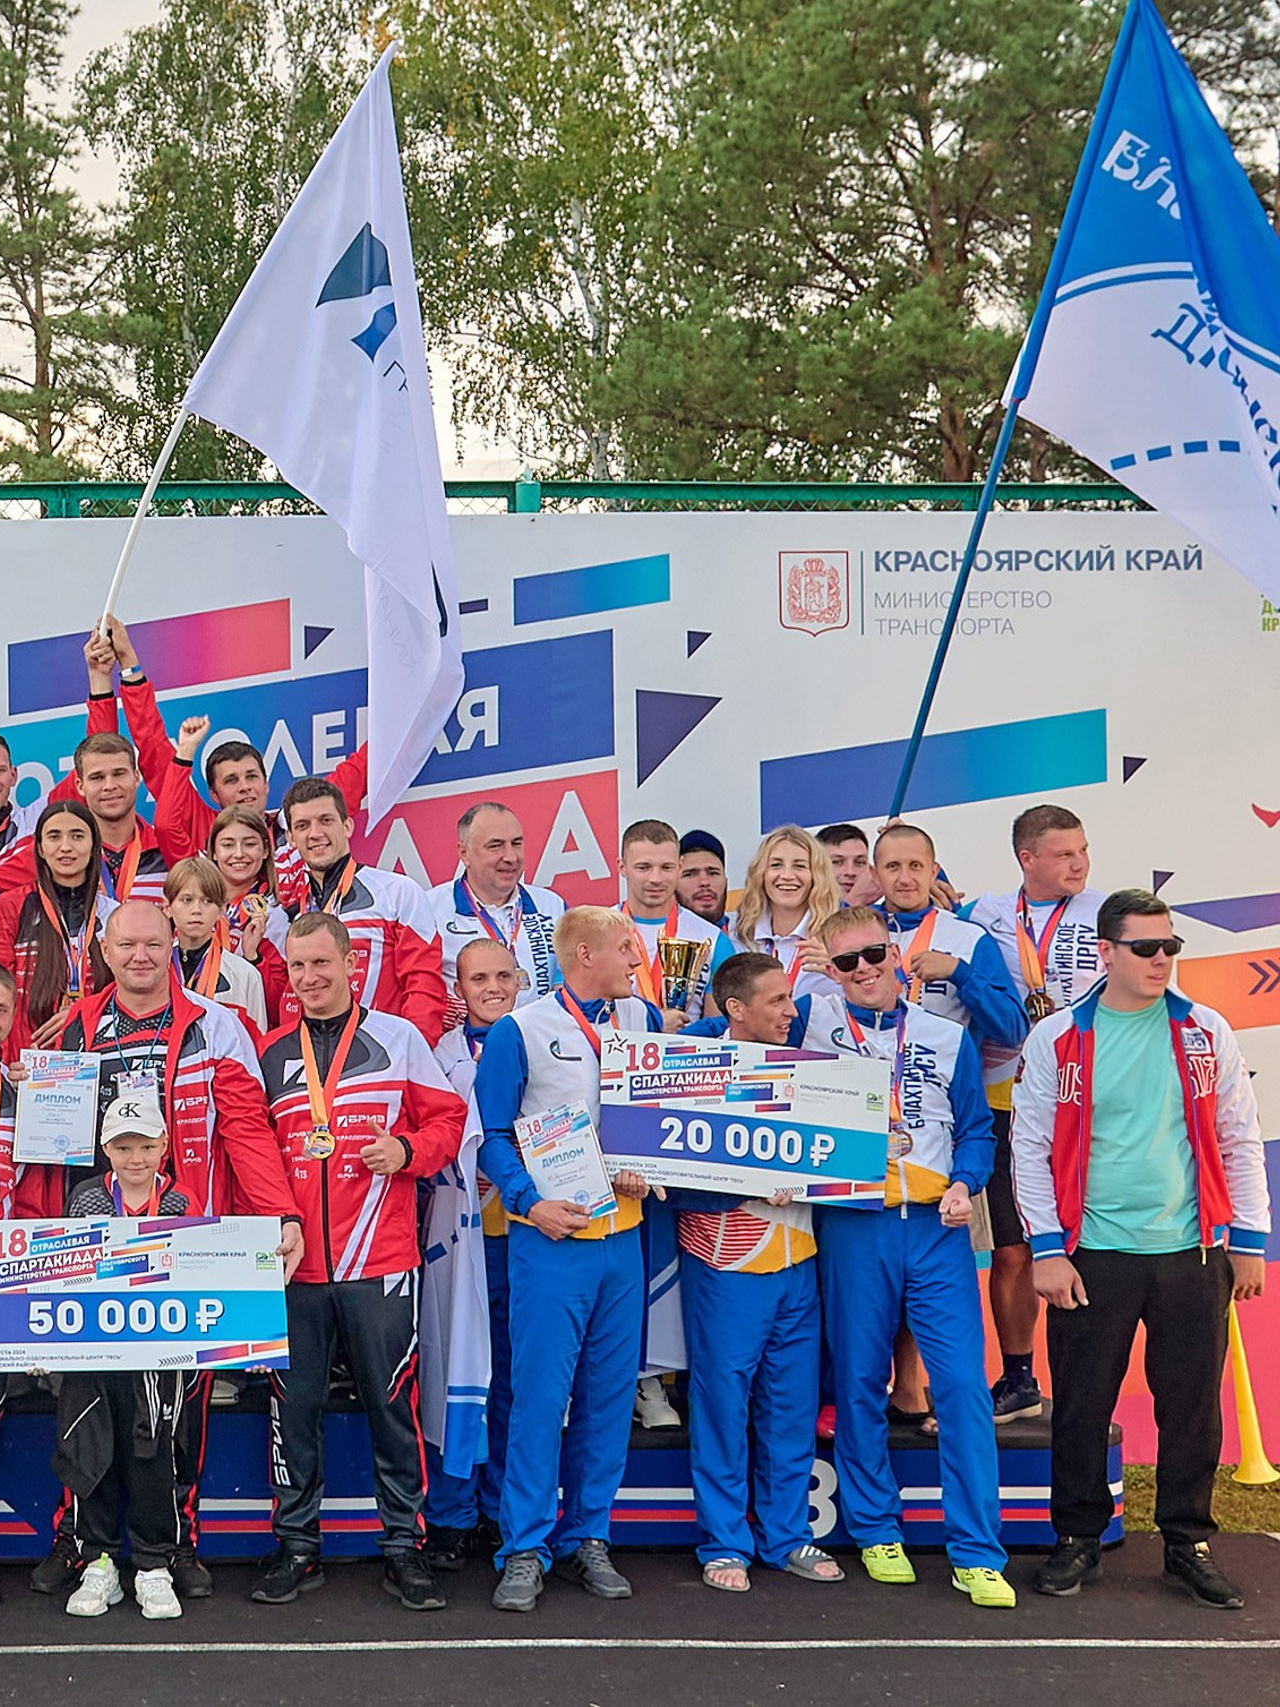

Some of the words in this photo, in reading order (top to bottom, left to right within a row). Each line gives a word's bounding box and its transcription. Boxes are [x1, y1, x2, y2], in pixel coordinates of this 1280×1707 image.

[1126, 545, 1203, 571] КРАЙ
[874, 590, 1052, 609] МИНИСЕРСТВО
[1077, 924, 1099, 971] ДРСУ
[32, 1056, 47, 1069] 18
[626, 1042, 660, 1071] 18
[664, 1057, 720, 1068] ОТРАСЛЕВАЯ
[631, 1071, 731, 1088] СПАРТАКИАДА
[684, 1084, 723, 1092] ТРАНСПОРТА
[34, 1094, 81, 1104] ДИПЛОМ
[526, 1119, 541, 1136] 18
[660, 1117, 712, 1153] 20
[542, 1147, 585, 1168] ДИПЛОМ
[31, 1236, 90, 1253] ОТРАСЛЕВАЯ
[0, 1249, 103, 1275] СПАРТАКИАДА
[52, 1263, 94, 1275] ТРАНСПОРТА
[28, 1300, 84, 1335] 50
